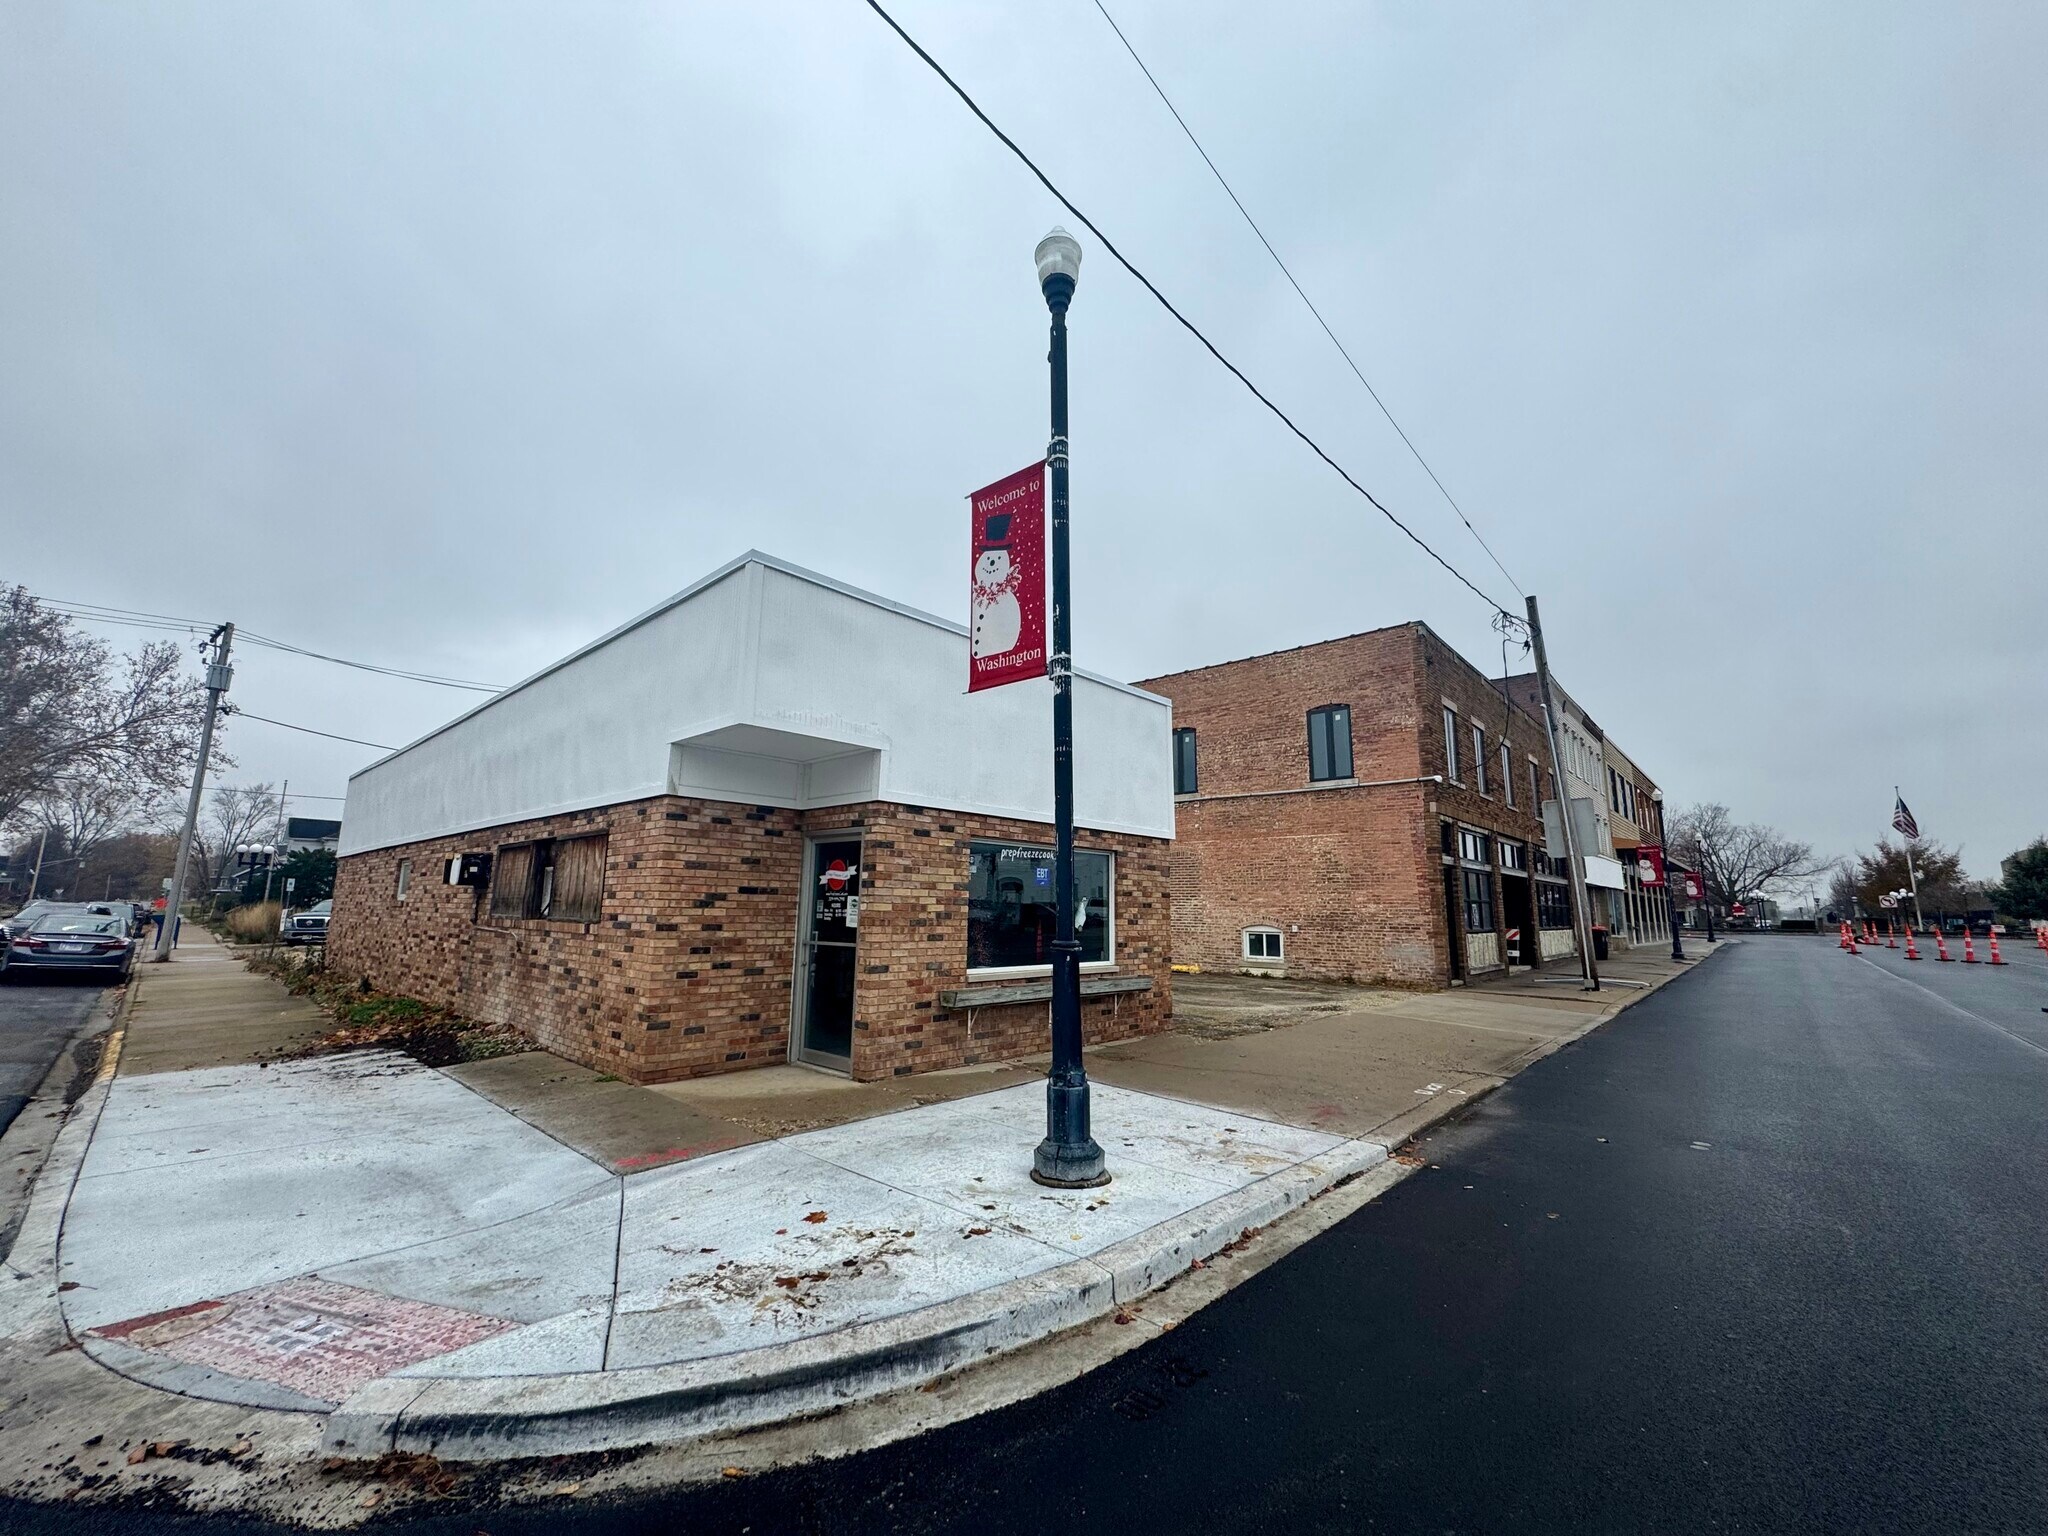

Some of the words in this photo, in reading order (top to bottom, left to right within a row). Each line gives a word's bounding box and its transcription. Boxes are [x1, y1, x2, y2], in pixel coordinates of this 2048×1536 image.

[977, 487, 1026, 514] Welcome
[1030, 480, 1040, 492] to
[976, 648, 1041, 673] Washington
[1036, 868, 1048, 878] EBT
